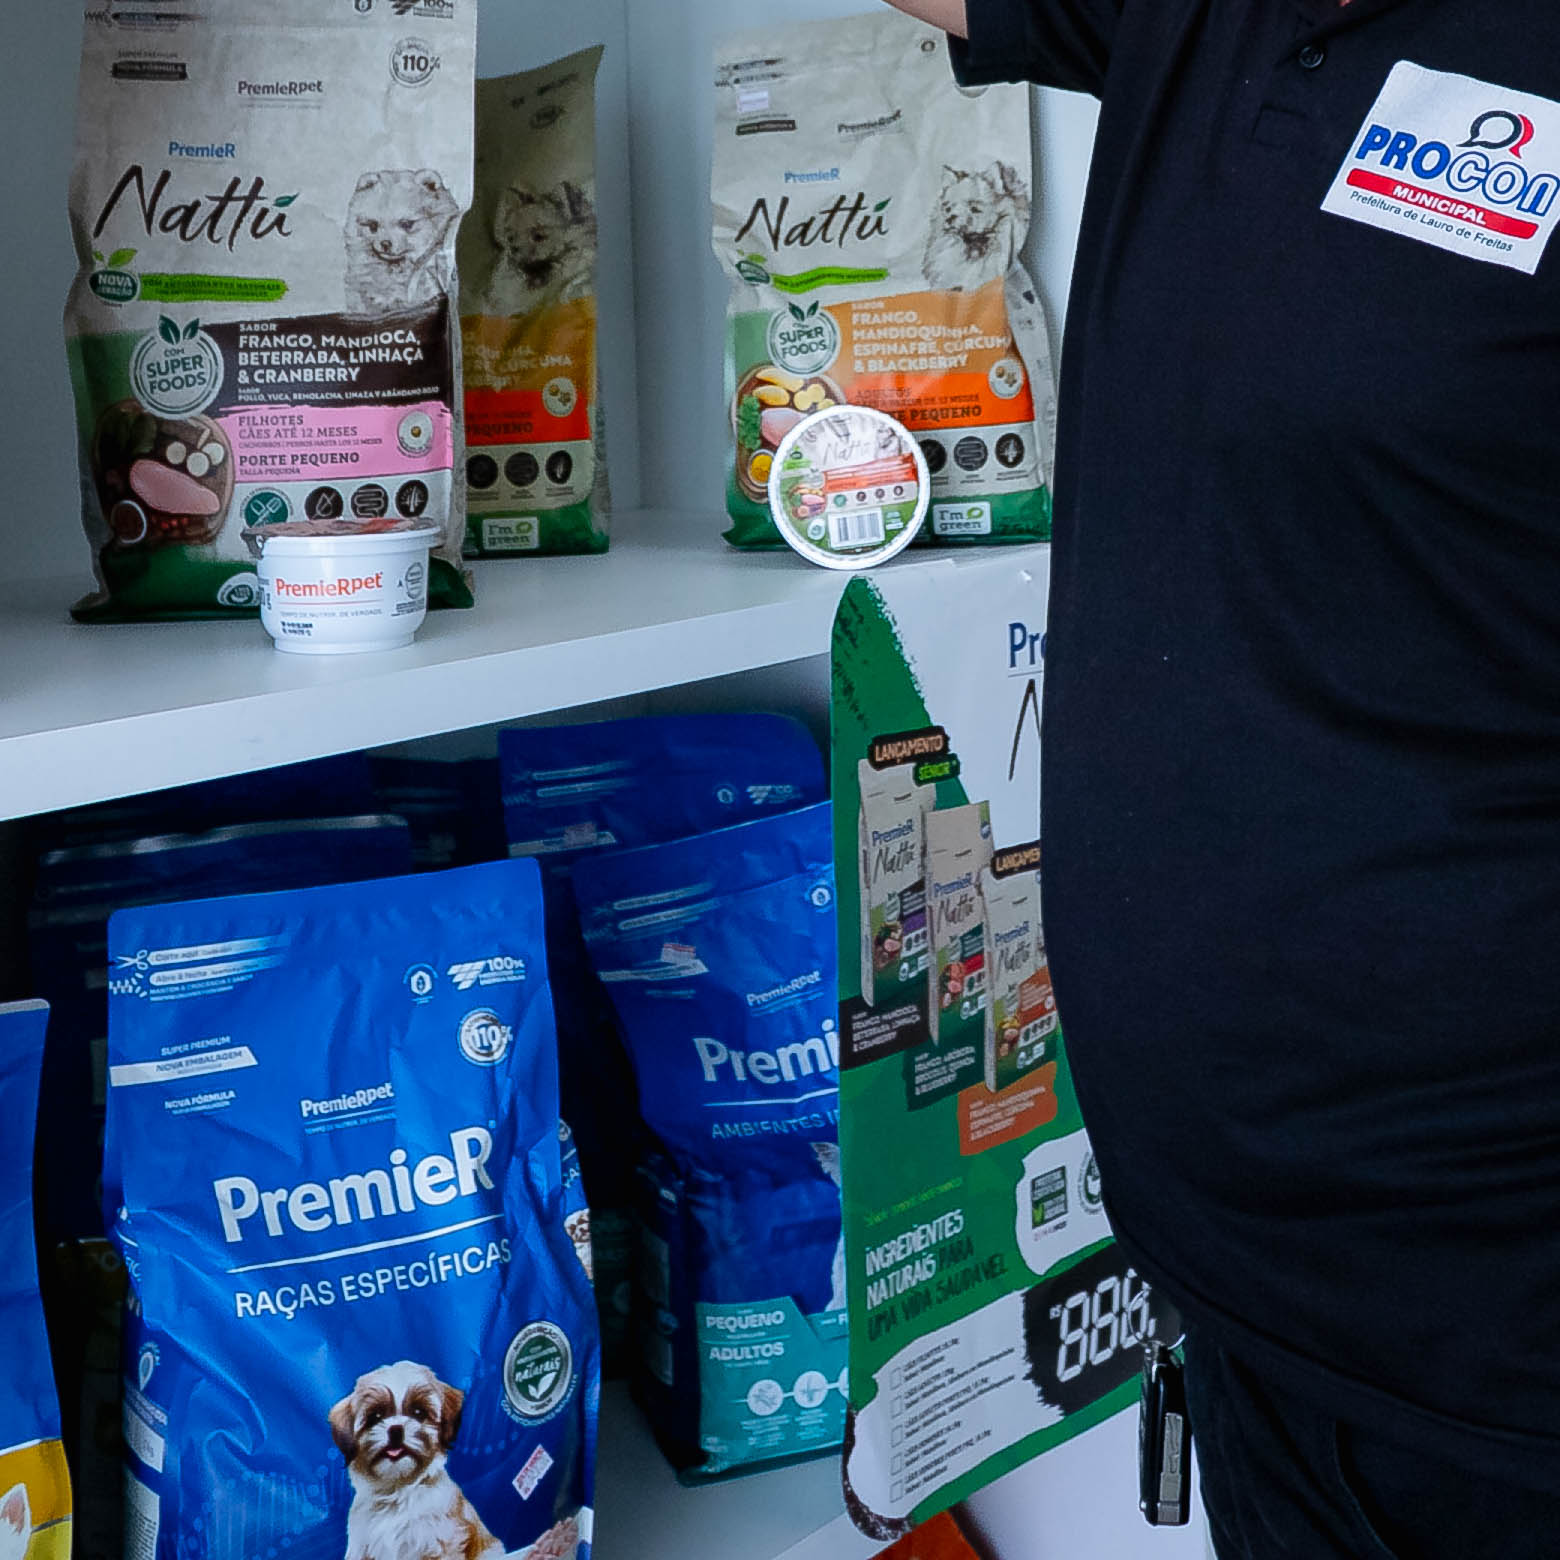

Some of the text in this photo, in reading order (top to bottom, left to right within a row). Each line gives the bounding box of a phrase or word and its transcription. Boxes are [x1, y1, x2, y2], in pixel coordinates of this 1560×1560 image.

[402, 54, 441, 73] 110%
[238, 79, 324, 96] PremieRpet
[168, 141, 236, 159] PremieR
[784, 168, 840, 183] PremieR
[1391, 184, 1487, 226] MUNICIPAL
[1350, 191, 1513, 252] Prefeitura de Lauro de Freitas
[98, 274, 133, 287] NOVA
[851, 311, 920, 325] FRANGO,
[239, 330, 421, 350] FRANGO, MANDIOCA,
[778, 327, 824, 342] SUPER
[239, 347, 424, 366] BETERRABA, LINHAÇA
[781, 343, 827, 358] FOODS
[854, 341, 941, 357] ESPINAFRE,
[146, 354, 204, 378] SUPER
[854, 354, 968, 373] & BLACKBERRY
[149, 372, 207, 394] FOODS
[237, 367, 361, 384] & CRANBERRY
[239, 415, 304, 426] FILHOTES
[910, 405, 982, 422] PEQUENO
[239, 423, 358, 440] CÃES ATÉ 12 MESES
[239, 452, 360, 467] PORTE PEQUENO
[939, 509, 964, 521] I'm
[939, 519, 983, 531] green
[276, 572, 383, 597] PremieRpet
[875, 734, 944, 764] LANÇAMENTO
[486, 956, 525, 973] 100%
[746, 970, 821, 1007] PremieRpet
[161, 1035, 231, 1057] SUPER PREMIUM
[692, 1018, 840, 1084] Premi
[155, 1049, 243, 1074] NOVA EMBALAGEM
[165, 1089, 236, 1110] NOVA FÓRMULA
[300, 1082, 394, 1118] PremieRpet
[212, 1125, 496, 1244] PremieR
[865, 1208, 964, 1277] INGREDIENTES
[234, 1240, 514, 1321] RAÇAS ESPECÍFICAS
[865, 1251, 936, 1311] NATURAIS
[706, 1311, 785, 1333] PEQUENO
[709, 1342, 784, 1360] ADULTOS
